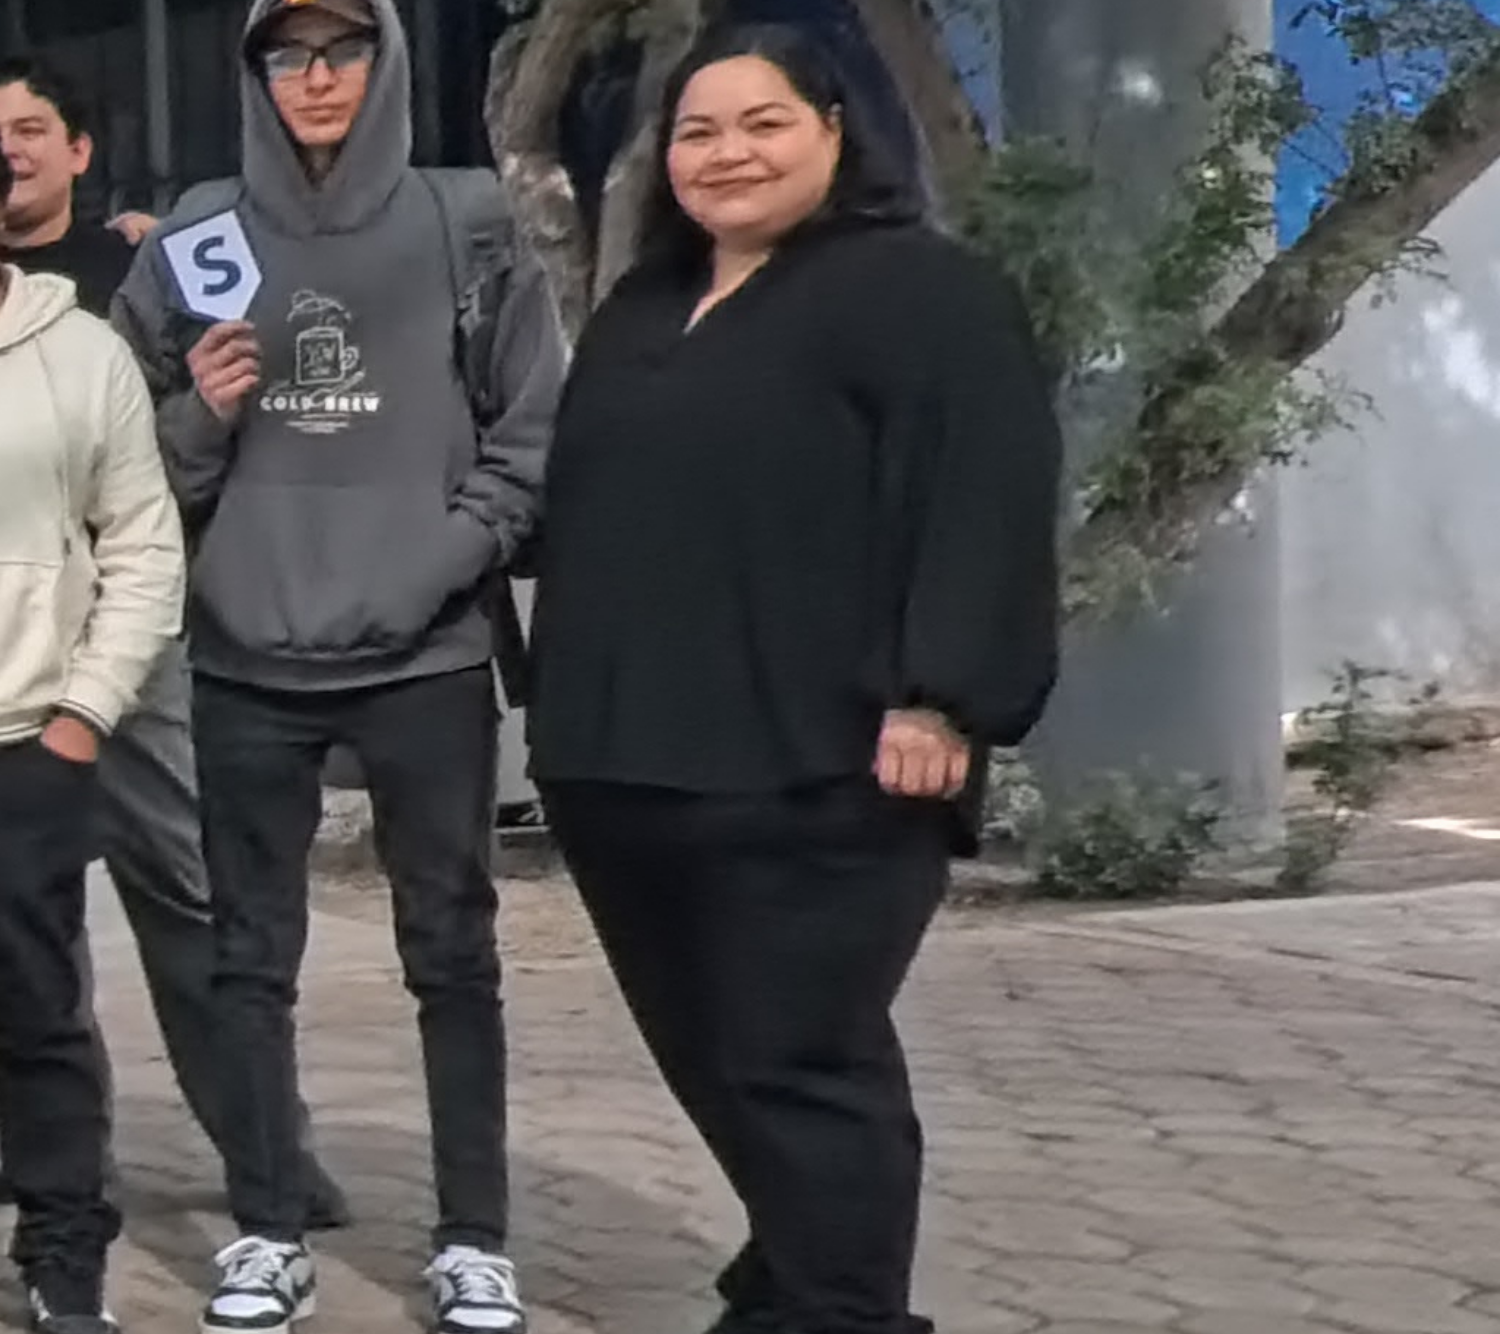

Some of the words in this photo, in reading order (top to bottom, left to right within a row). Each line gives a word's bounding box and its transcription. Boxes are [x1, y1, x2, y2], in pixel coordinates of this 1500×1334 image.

[192, 236, 242, 296] S
[259, 395, 313, 411] COLD
[324, 395, 380, 412] BREW
